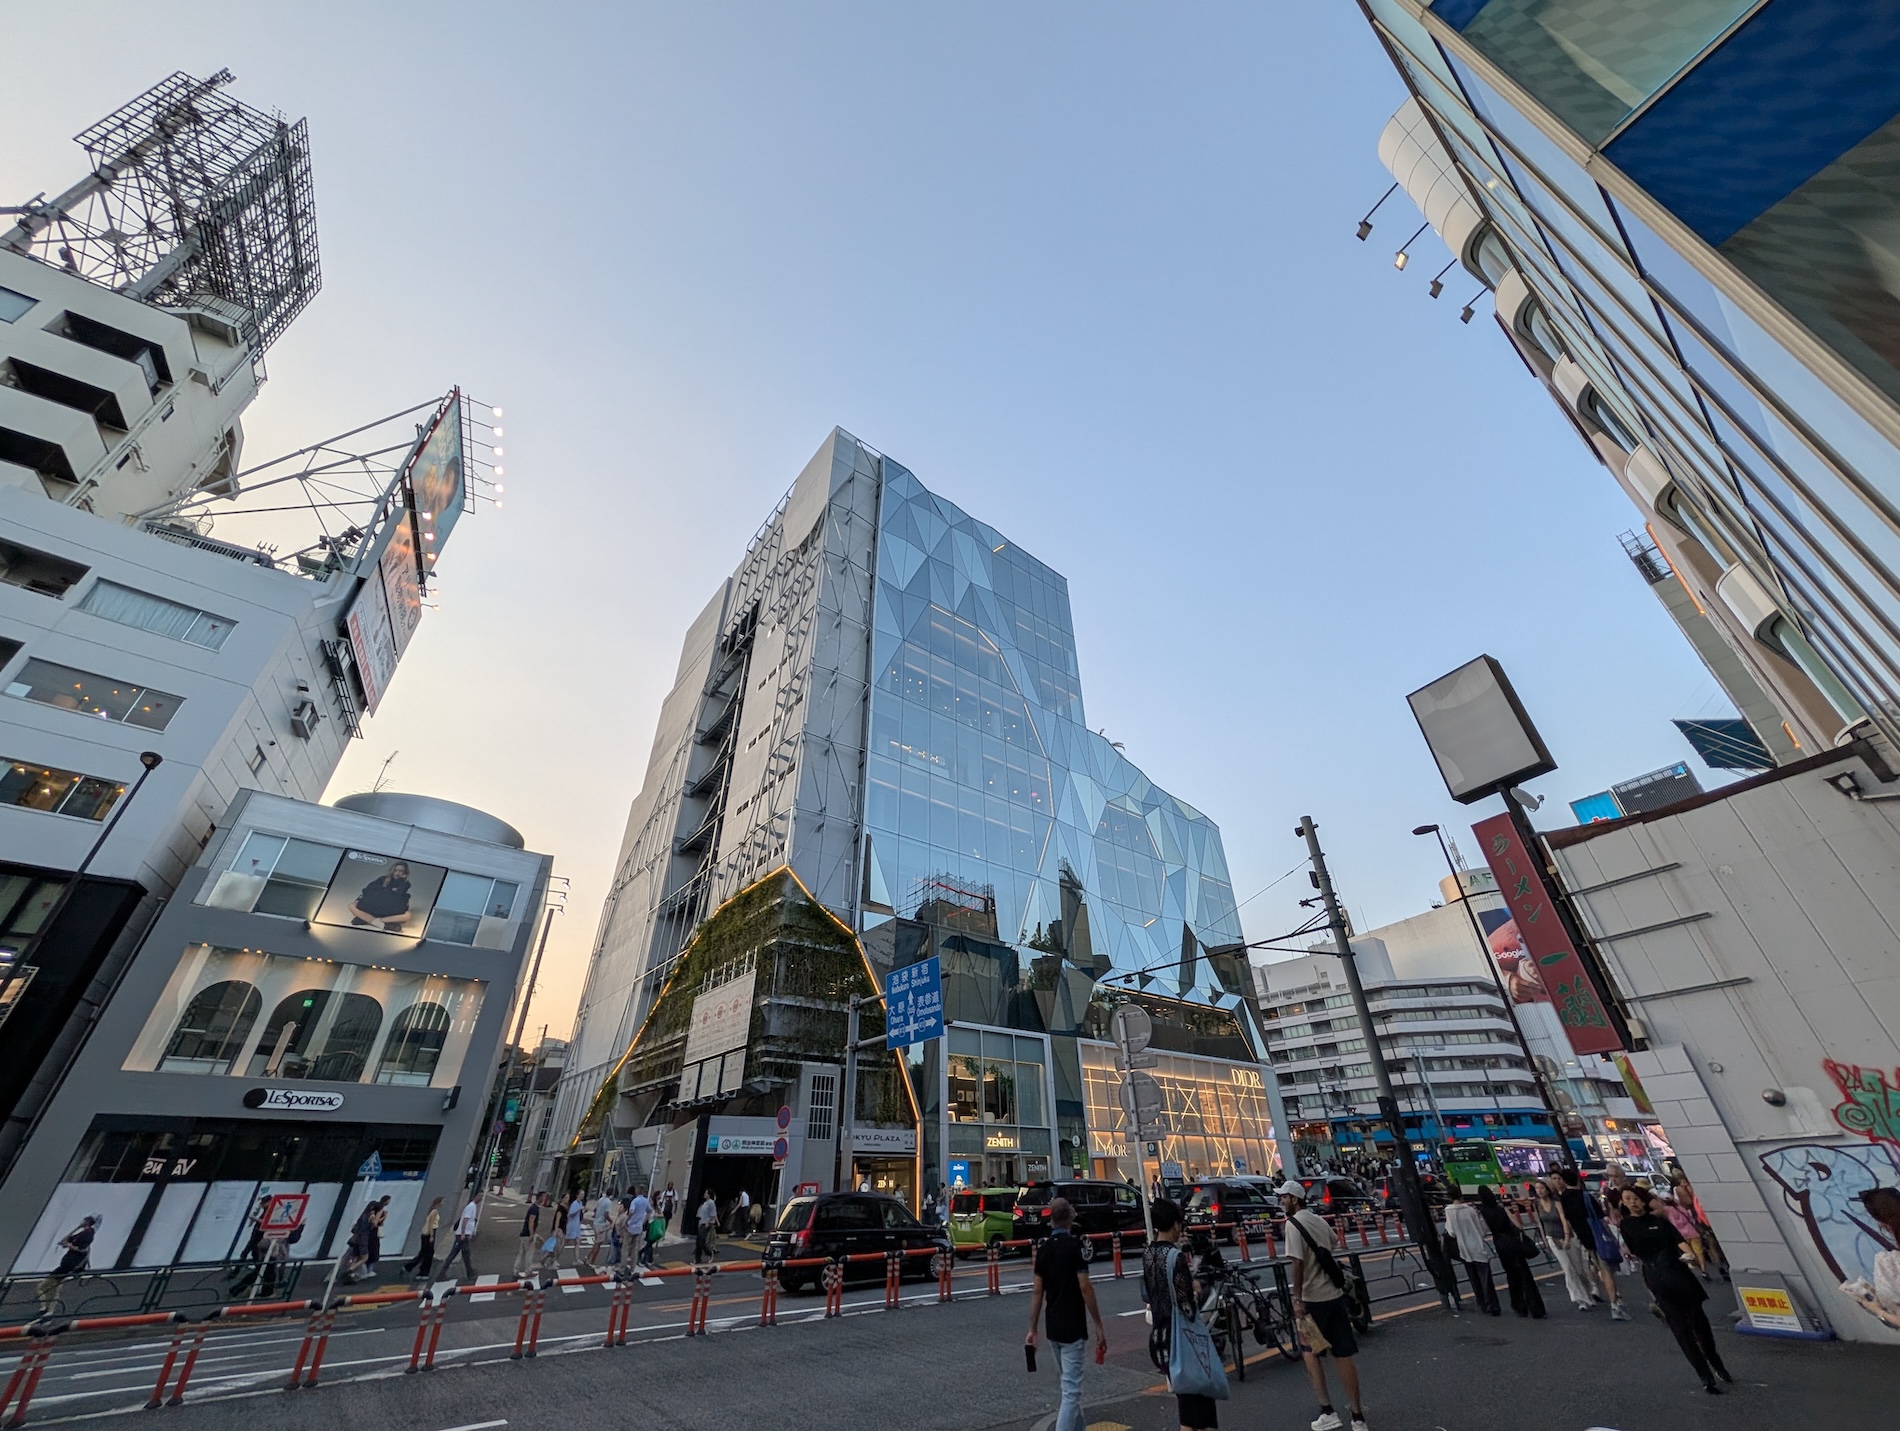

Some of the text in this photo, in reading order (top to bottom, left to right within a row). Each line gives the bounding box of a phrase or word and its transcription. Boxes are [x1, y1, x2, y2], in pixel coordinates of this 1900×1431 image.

[1492, 833, 1543, 924] ラーメン
[1494, 949, 1525, 959] Google
[911, 963, 929, 978] 新宿
[1539, 951, 1607, 1028] 一蘭
[917, 990, 939, 1008] 表参道
[1232, 1069, 1261, 1088] DIOR
[873, 1134, 901, 1142] PLAZA
[986, 1137, 1014, 1148] ZENITH
[1104, 1143, 1128, 1157] DIOR
[1028, 1164, 1047, 1172] ZENITH
[1746, 1296, 1790, 1310] 使用禁止
